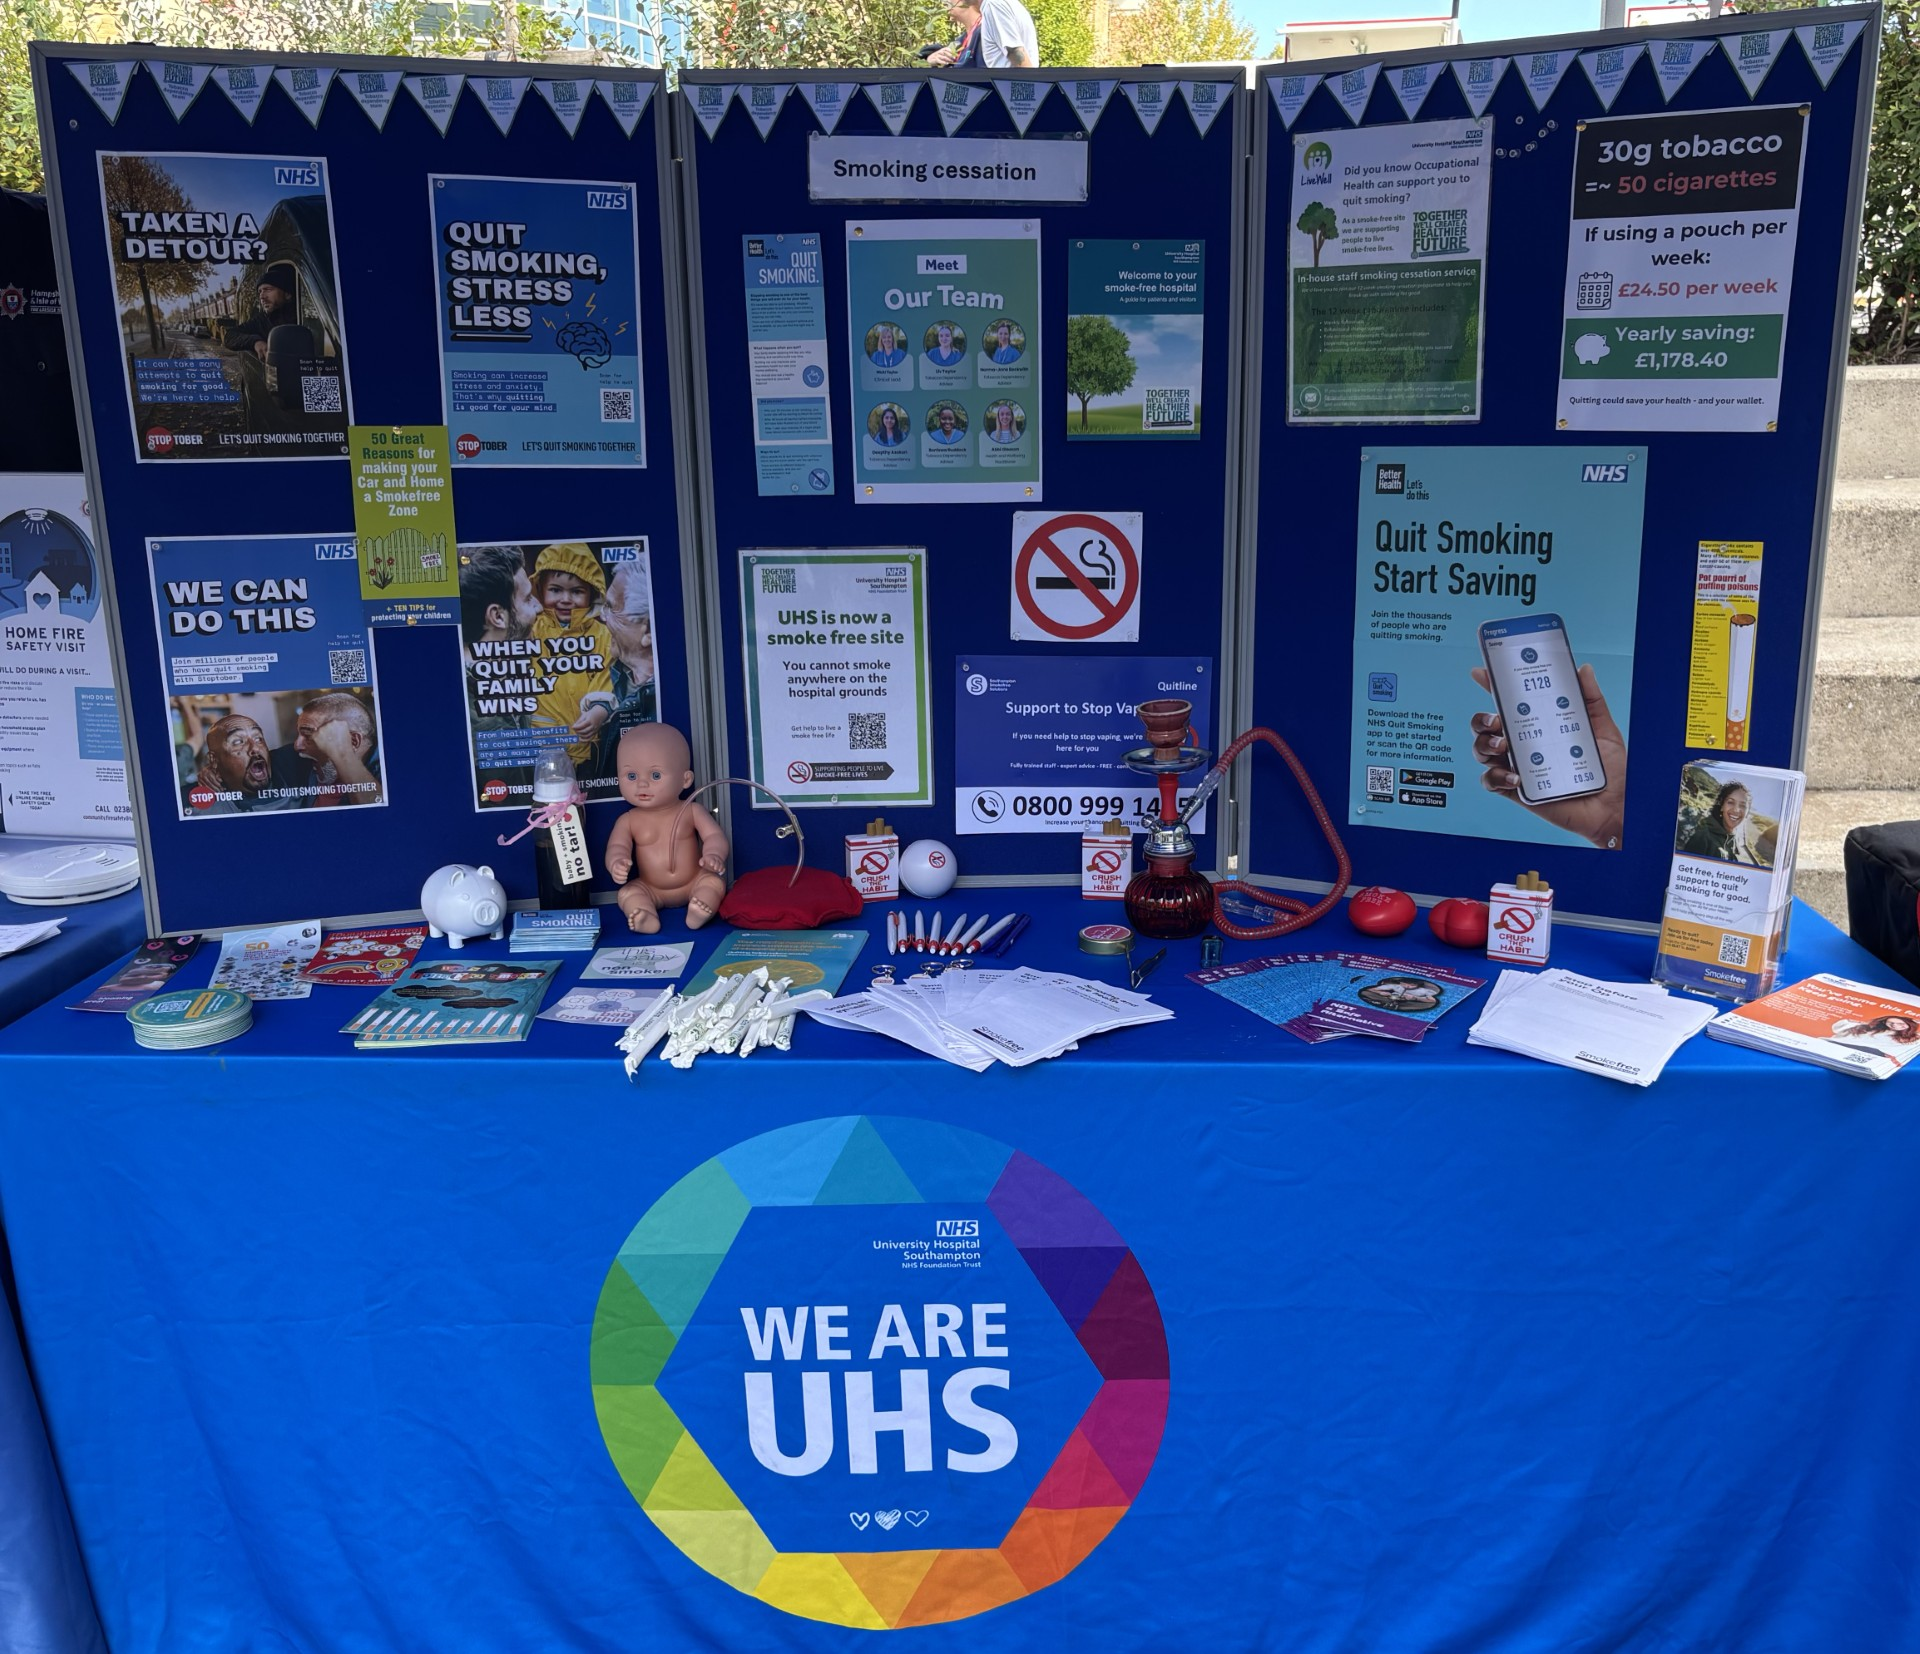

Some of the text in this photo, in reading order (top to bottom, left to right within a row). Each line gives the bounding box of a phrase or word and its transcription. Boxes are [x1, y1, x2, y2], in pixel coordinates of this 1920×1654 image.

[1811, 52, 1843, 62] dependency
[1598, 134, 1783, 166] 30g tobacco
[833, 159, 1036, 182] Smoking cessation
[1344, 157, 1479, 176] Did you know Occupational
[277, 168, 316, 185] NHS
[1301, 173, 1332, 186] LiveWell
[1343, 174, 1470, 191] Health can support you to
[1617, 169, 1777, 196] 50 cigarettes
[588, 193, 625, 208] NHS
[1342, 193, 1410, 207] quit smoking?
[121, 212, 260, 235] TAKEN A
[449, 222, 526, 247] QUIT
[1585, 220, 1788, 243] If using a pouch per
[125, 238, 268, 261] DETOUR?
[451, 250, 607, 280] SMOKING,
[791, 252, 818, 268] QUIT
[925, 259, 959, 271] Meet
[1651, 249, 1711, 266] week:
[759, 268, 820, 285] SMOKING.
[1118, 271, 1197, 282] Welcome to your
[452, 277, 572, 301] STRESS
[1104, 283, 1197, 293] smoke-free hospital
[1618, 278, 1778, 299] £24.50 per week
[884, 285, 1004, 310] Our Team
[454, 305, 532, 327] LESS
[1615, 323, 1755, 345] Yearly saving:
[1634, 352, 1728, 371] £1,178.40
[1569, 396, 1601, 406] Quitting
[1602, 396, 1624, 404] could
[1645, 398, 1664, 406] your
[1665, 396, 1691, 405] health
[219, 432, 344, 445] LET'S QUIT SMOKING TOGETHER
[371, 432, 424, 444] 50 Great
[362, 447, 435, 459] Reasons for
[362, 462, 438, 476] making your
[1583, 465, 1627, 482] NHS
[357, 476, 445, 488] Car and Home
[363, 490, 441, 502] a Smokefree
[388, 505, 418, 517] Zone
[1375, 520, 1553, 565] Quit Smoking
[317, 545, 355, 559] NHS
[603, 547, 638, 562] NHS
[1373, 561, 1537, 606] Start Saving
[1698, 574, 1747, 583] Pot pourri of
[167, 578, 308, 604] WE CAN
[1698, 582, 1759, 591] puffing poisons
[173, 607, 317, 633] DO THIS
[778, 610, 892, 625] UHS is now a
[5, 627, 85, 640] HOME FIRE
[767, 630, 904, 645] smoke free site
[6, 641, 85, 652] SAFETY VISIT
[472, 636, 595, 657] WHEN YOU
[475, 655, 604, 677] QUIT, YOUR
[783, 660, 891, 671] You cannot smoke
[477, 677, 558, 695] FAMILY
[787, 673, 887, 686] anywhere on the
[1157, 681, 1198, 692] Quitline
[1524, 676, 1551, 692] £128
[789, 686, 887, 699] hospital grounds
[477, 697, 538, 715] WINS
[1005, 701, 1112, 716] Support to Stop
[500, 730, 529, 738] health
[1019, 734, 1033, 742] you
[1053, 733, 1069, 742] help
[1080, 733, 1095, 742] stop
[1518, 729, 1543, 741] £11.99
[1537, 780, 1552, 790] £15
[1013, 796, 1123, 816] 0800 999
[575, 857, 585, 876] no
[861, 874, 890, 883] CRUSH
[1678, 864, 1749, 885] Get free, friendly
[1676, 874, 1738, 892] support to quit
[1674, 883, 1751, 904] smoking for good.
[532, 919, 596, 927] SMOKING.
[1498, 933, 1534, 943] CRUSH
[1500, 945, 1532, 955] HABIT
[1704, 968, 1747, 985] Smokefree
[979, 1026, 1024, 1051] Smokefree
[1578, 1050, 1641, 1073] Smokefree
[938, 1221, 977, 1236] NHS
[872, 1239, 980, 1251] University Hospital
[903, 1250, 981, 1262] Southampton
[919, 1261, 961, 1269] Foundation
[740, 1303, 1009, 1360] WE ARE
[744, 1366, 1019, 1477] UHS
